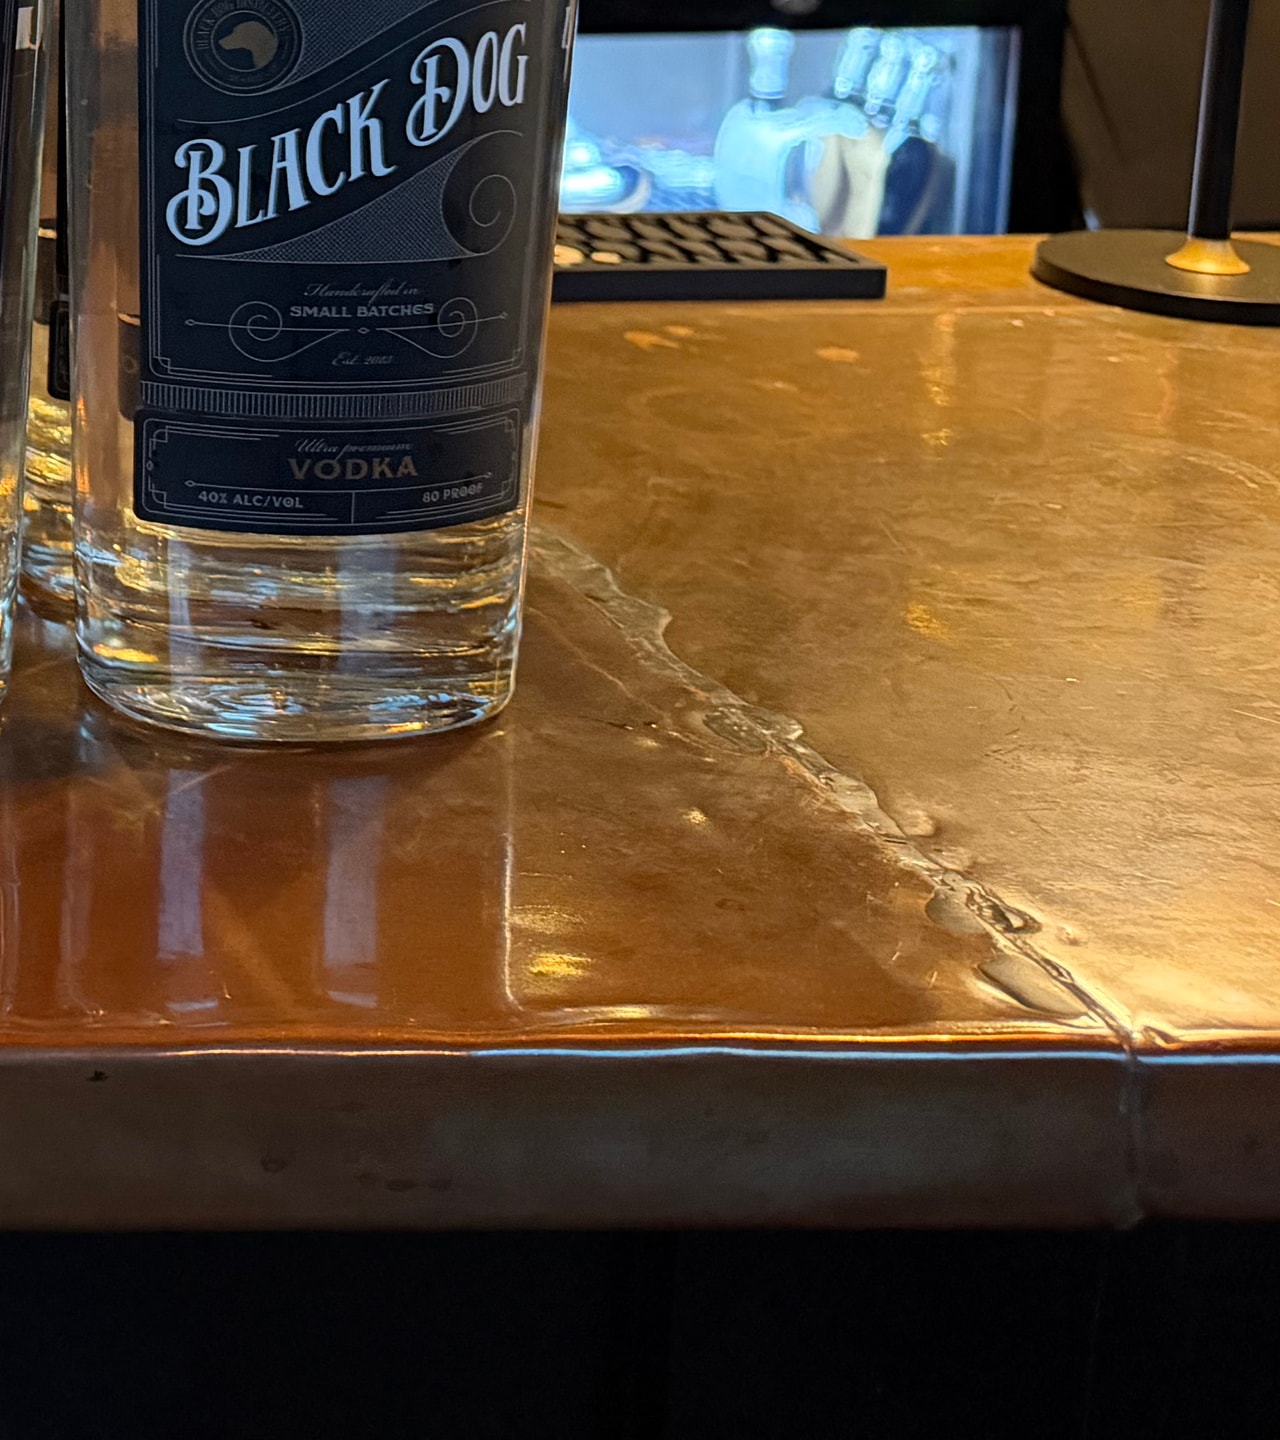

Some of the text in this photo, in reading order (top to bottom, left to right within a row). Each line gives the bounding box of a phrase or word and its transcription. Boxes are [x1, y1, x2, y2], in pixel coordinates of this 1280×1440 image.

[165, 22, 530, 247] BLACK DOG
[289, 301, 435, 318] SMALL BATCHES
[287, 455, 418, 481] VODKA
[232, 493, 304, 510] ALC/VOL
[421, 482, 484, 504] 80 PROOF
